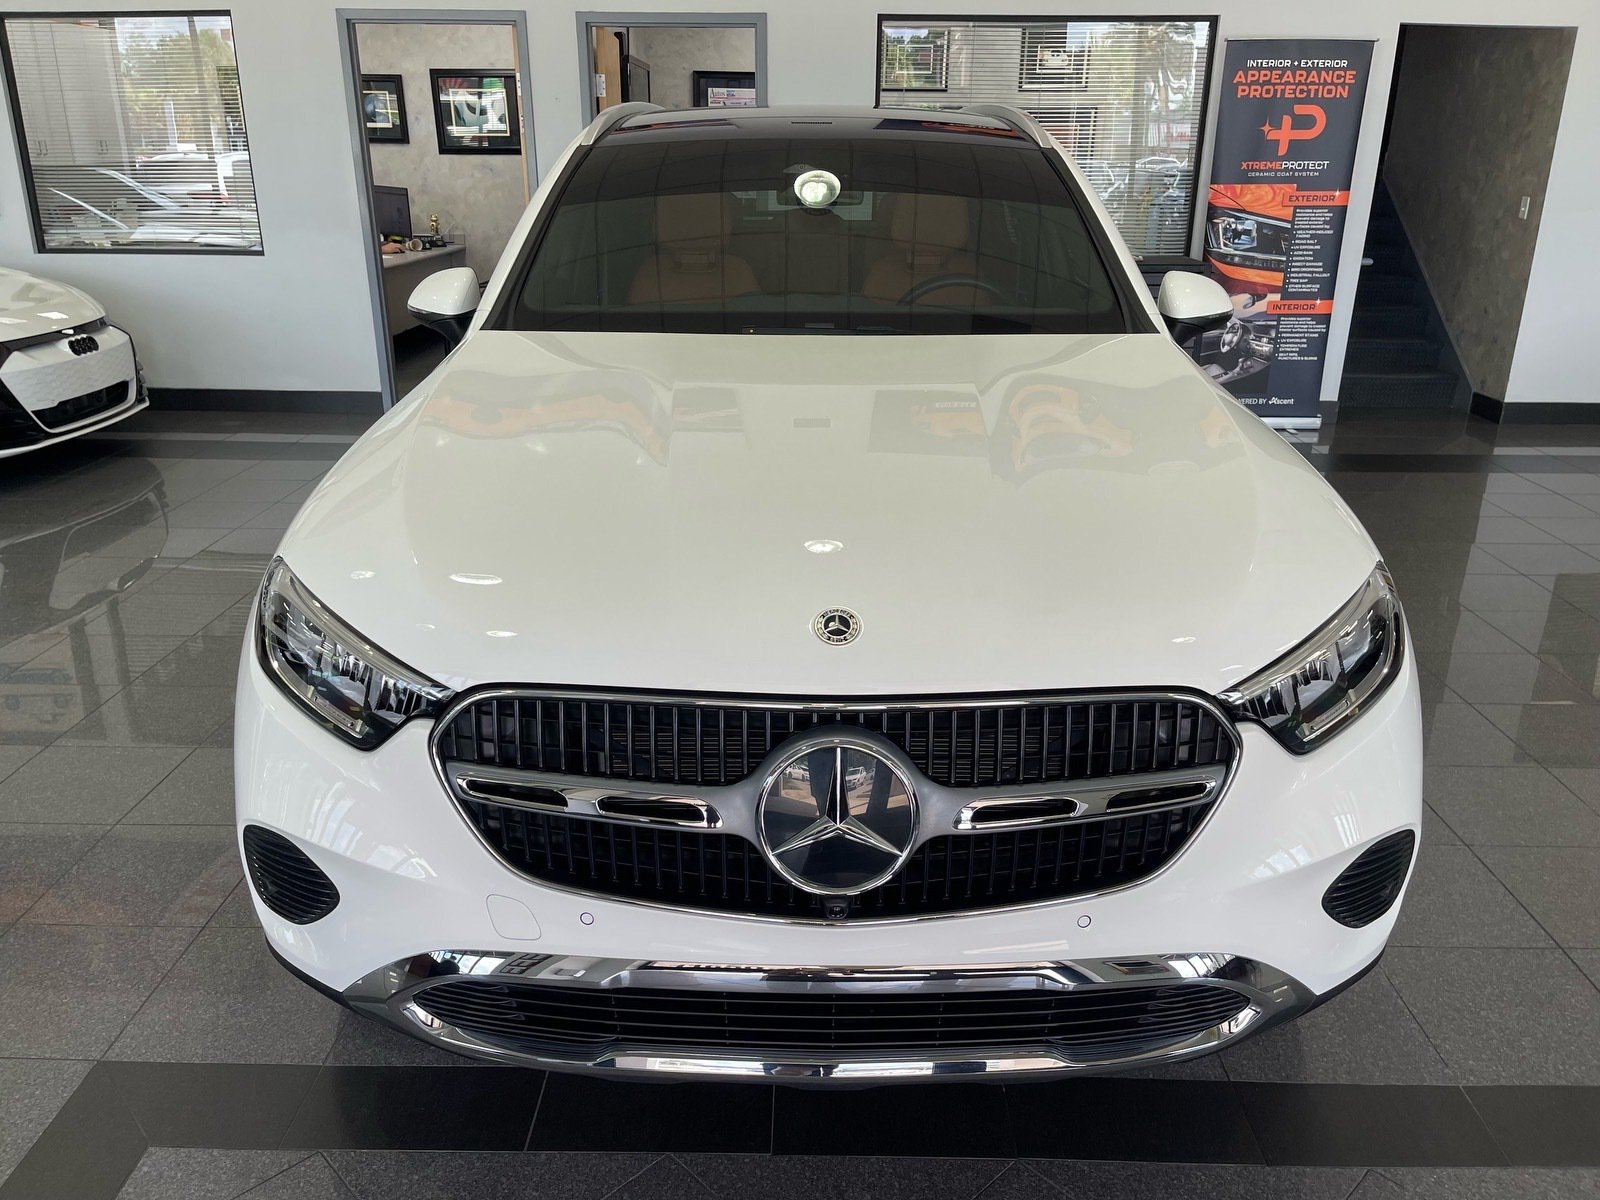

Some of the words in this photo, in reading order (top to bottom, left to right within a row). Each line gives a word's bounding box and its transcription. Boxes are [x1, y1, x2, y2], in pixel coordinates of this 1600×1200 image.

[1247, 60, 1291, 68] INTERIOR
[1300, 60, 1348, 68] EXTERIOR
[1233, 71, 1356, 84] APPEARANCE
[1237, 85, 1349, 98] PROTECTION
[1241, 161, 1329, 170] XTREMEPROTECT
[1272, 303, 1316, 311] INTERIOR
